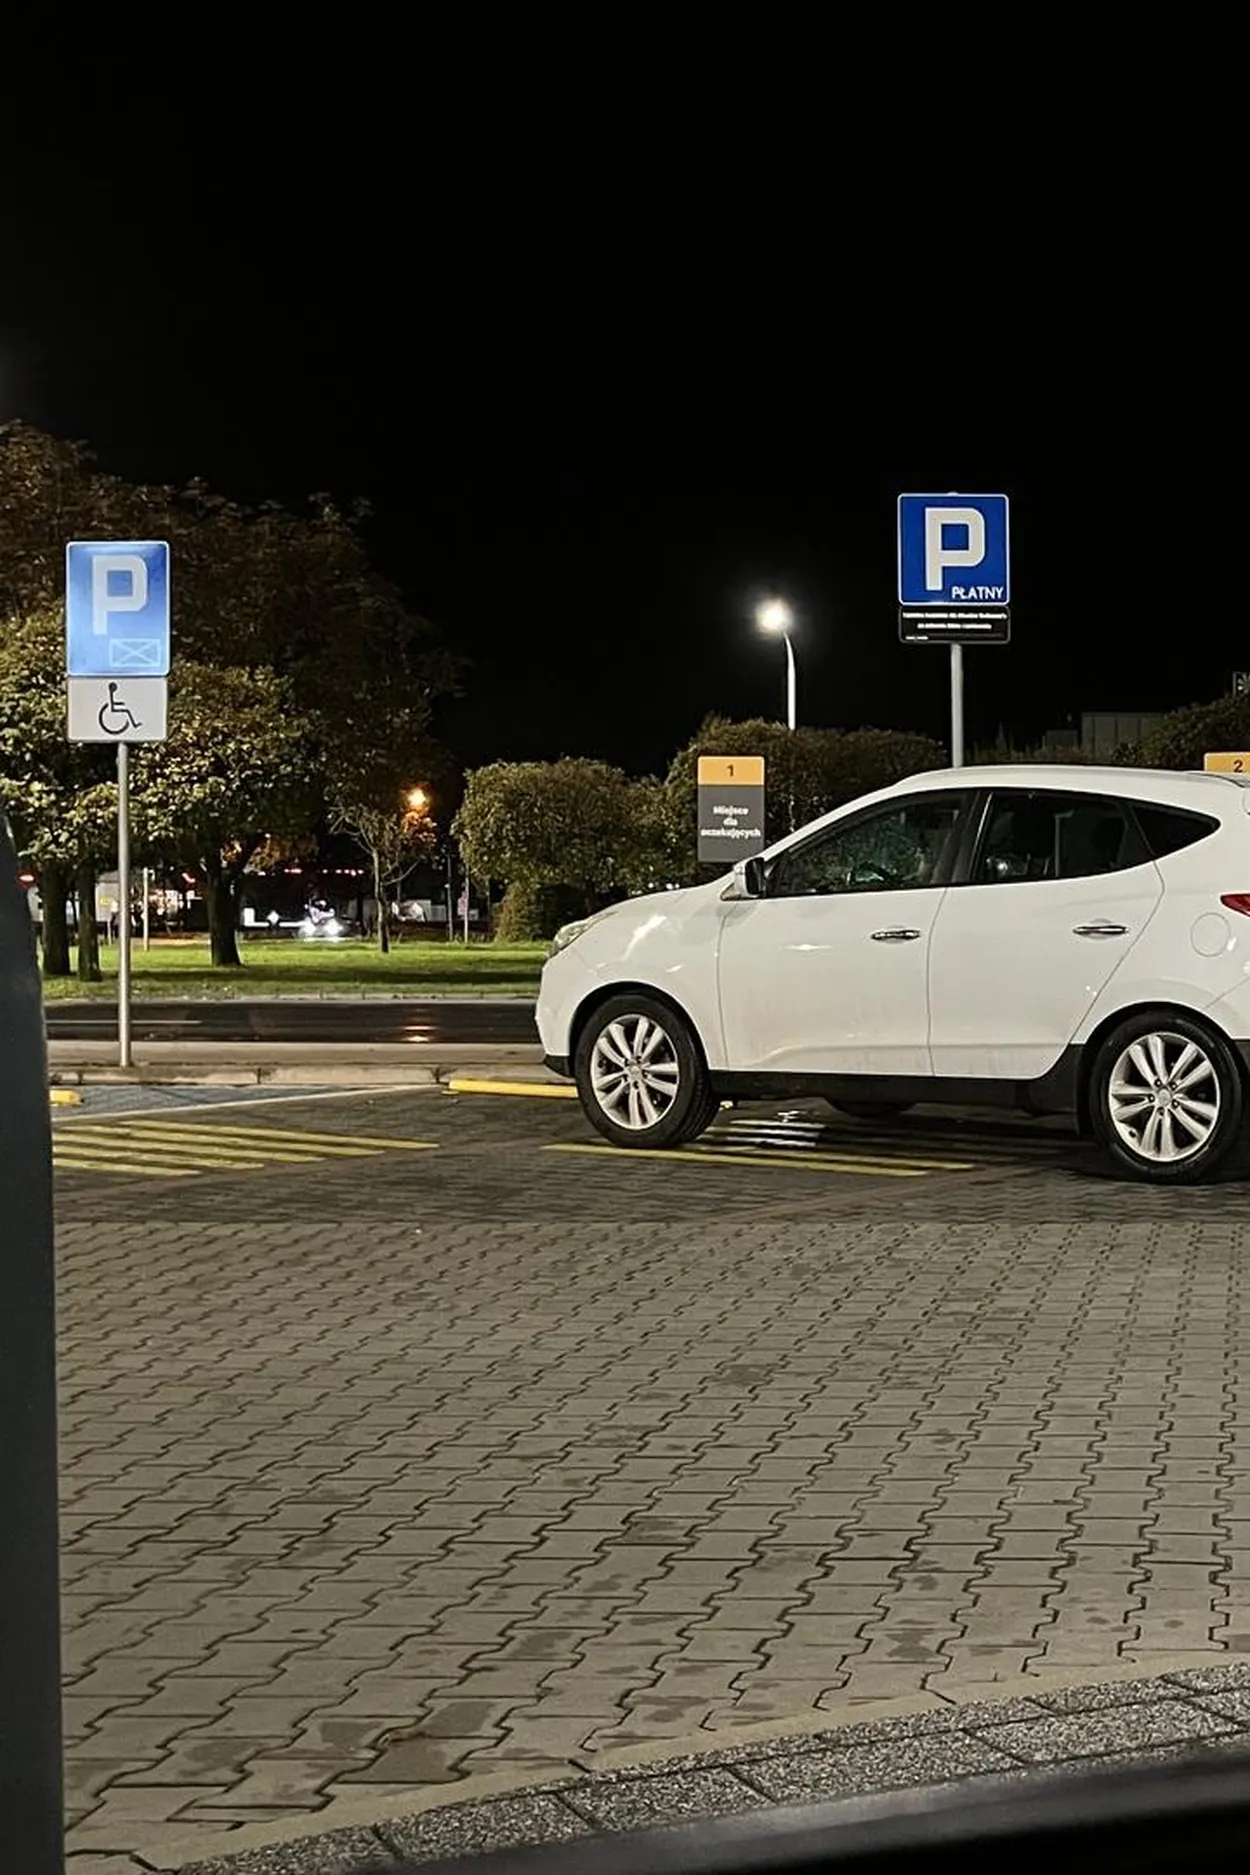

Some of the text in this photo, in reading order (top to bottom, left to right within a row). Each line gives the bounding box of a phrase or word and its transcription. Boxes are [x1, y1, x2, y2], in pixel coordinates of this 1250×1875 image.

[925, 506, 986, 591] P
[91, 554, 148, 635] P
[951, 586, 1004, 599] PŁATNY
[726, 764, 735, 777] 1
[1233, 759, 1243, 773] 2
